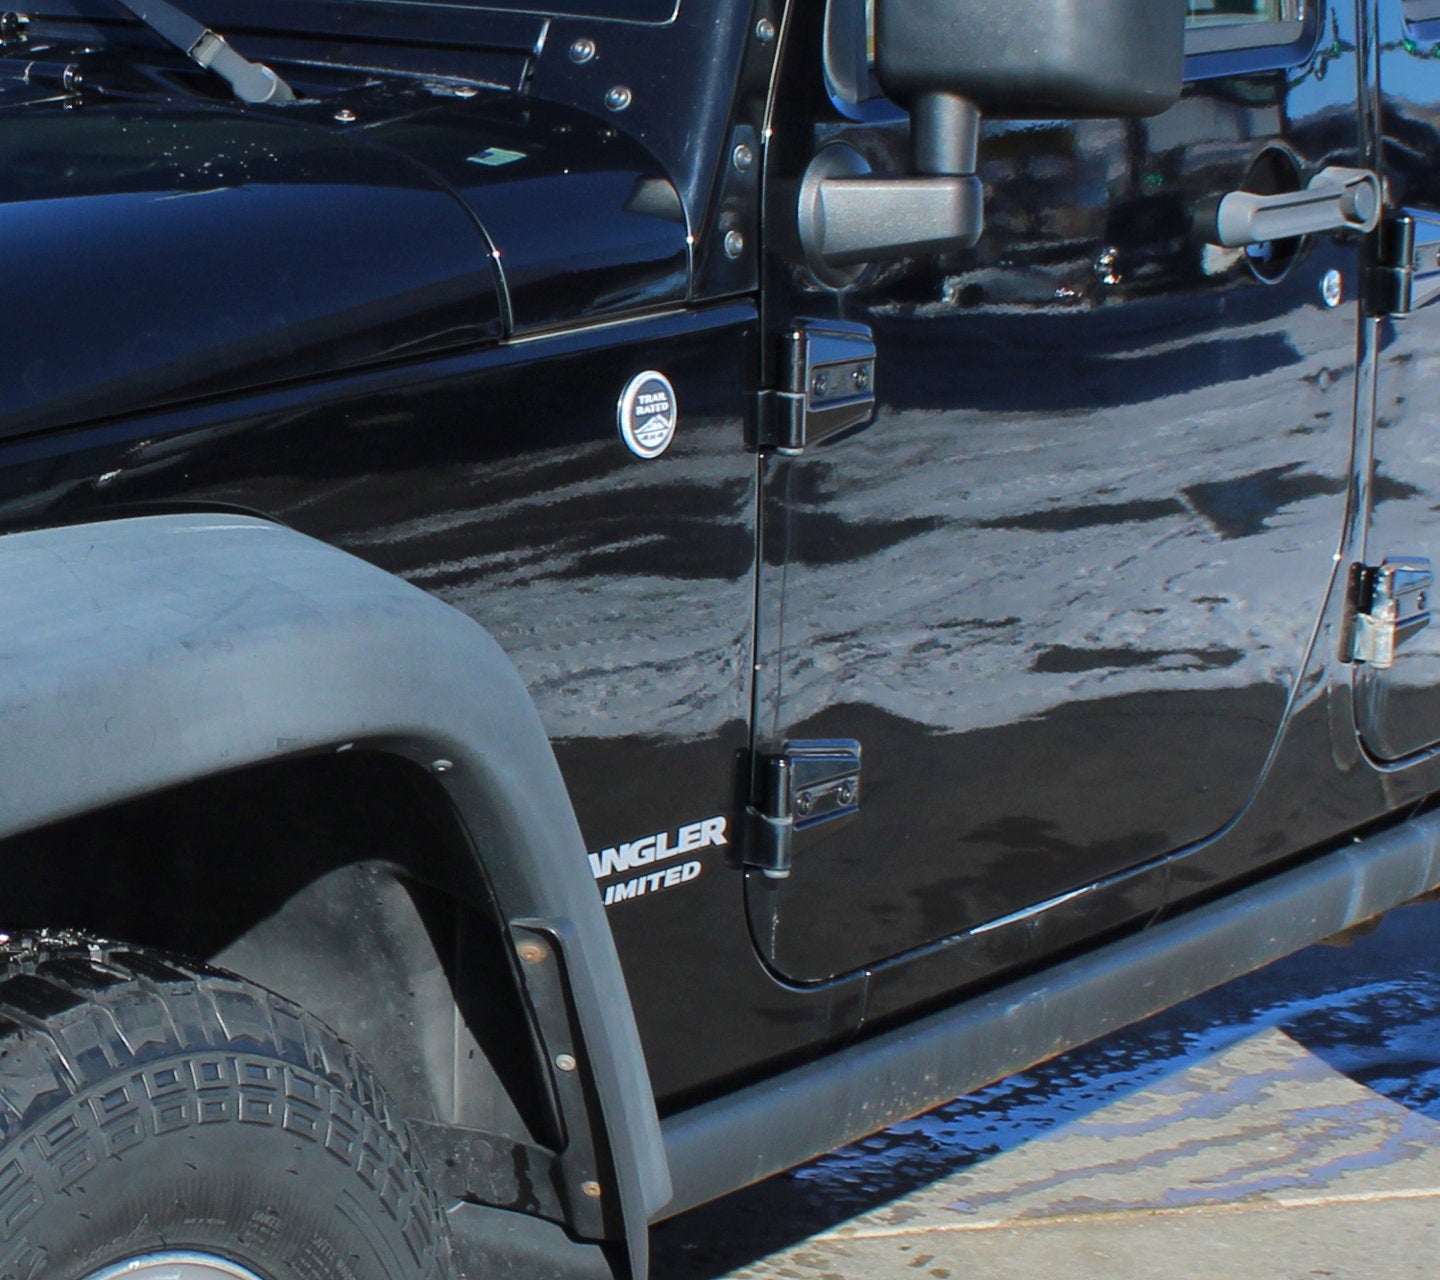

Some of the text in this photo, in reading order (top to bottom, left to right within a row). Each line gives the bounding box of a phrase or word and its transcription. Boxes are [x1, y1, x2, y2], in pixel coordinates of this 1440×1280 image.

[638, 391, 669, 405] TRAIL
[635, 402, 670, 416] RATED
[602, 860, 703, 906] IMITED
